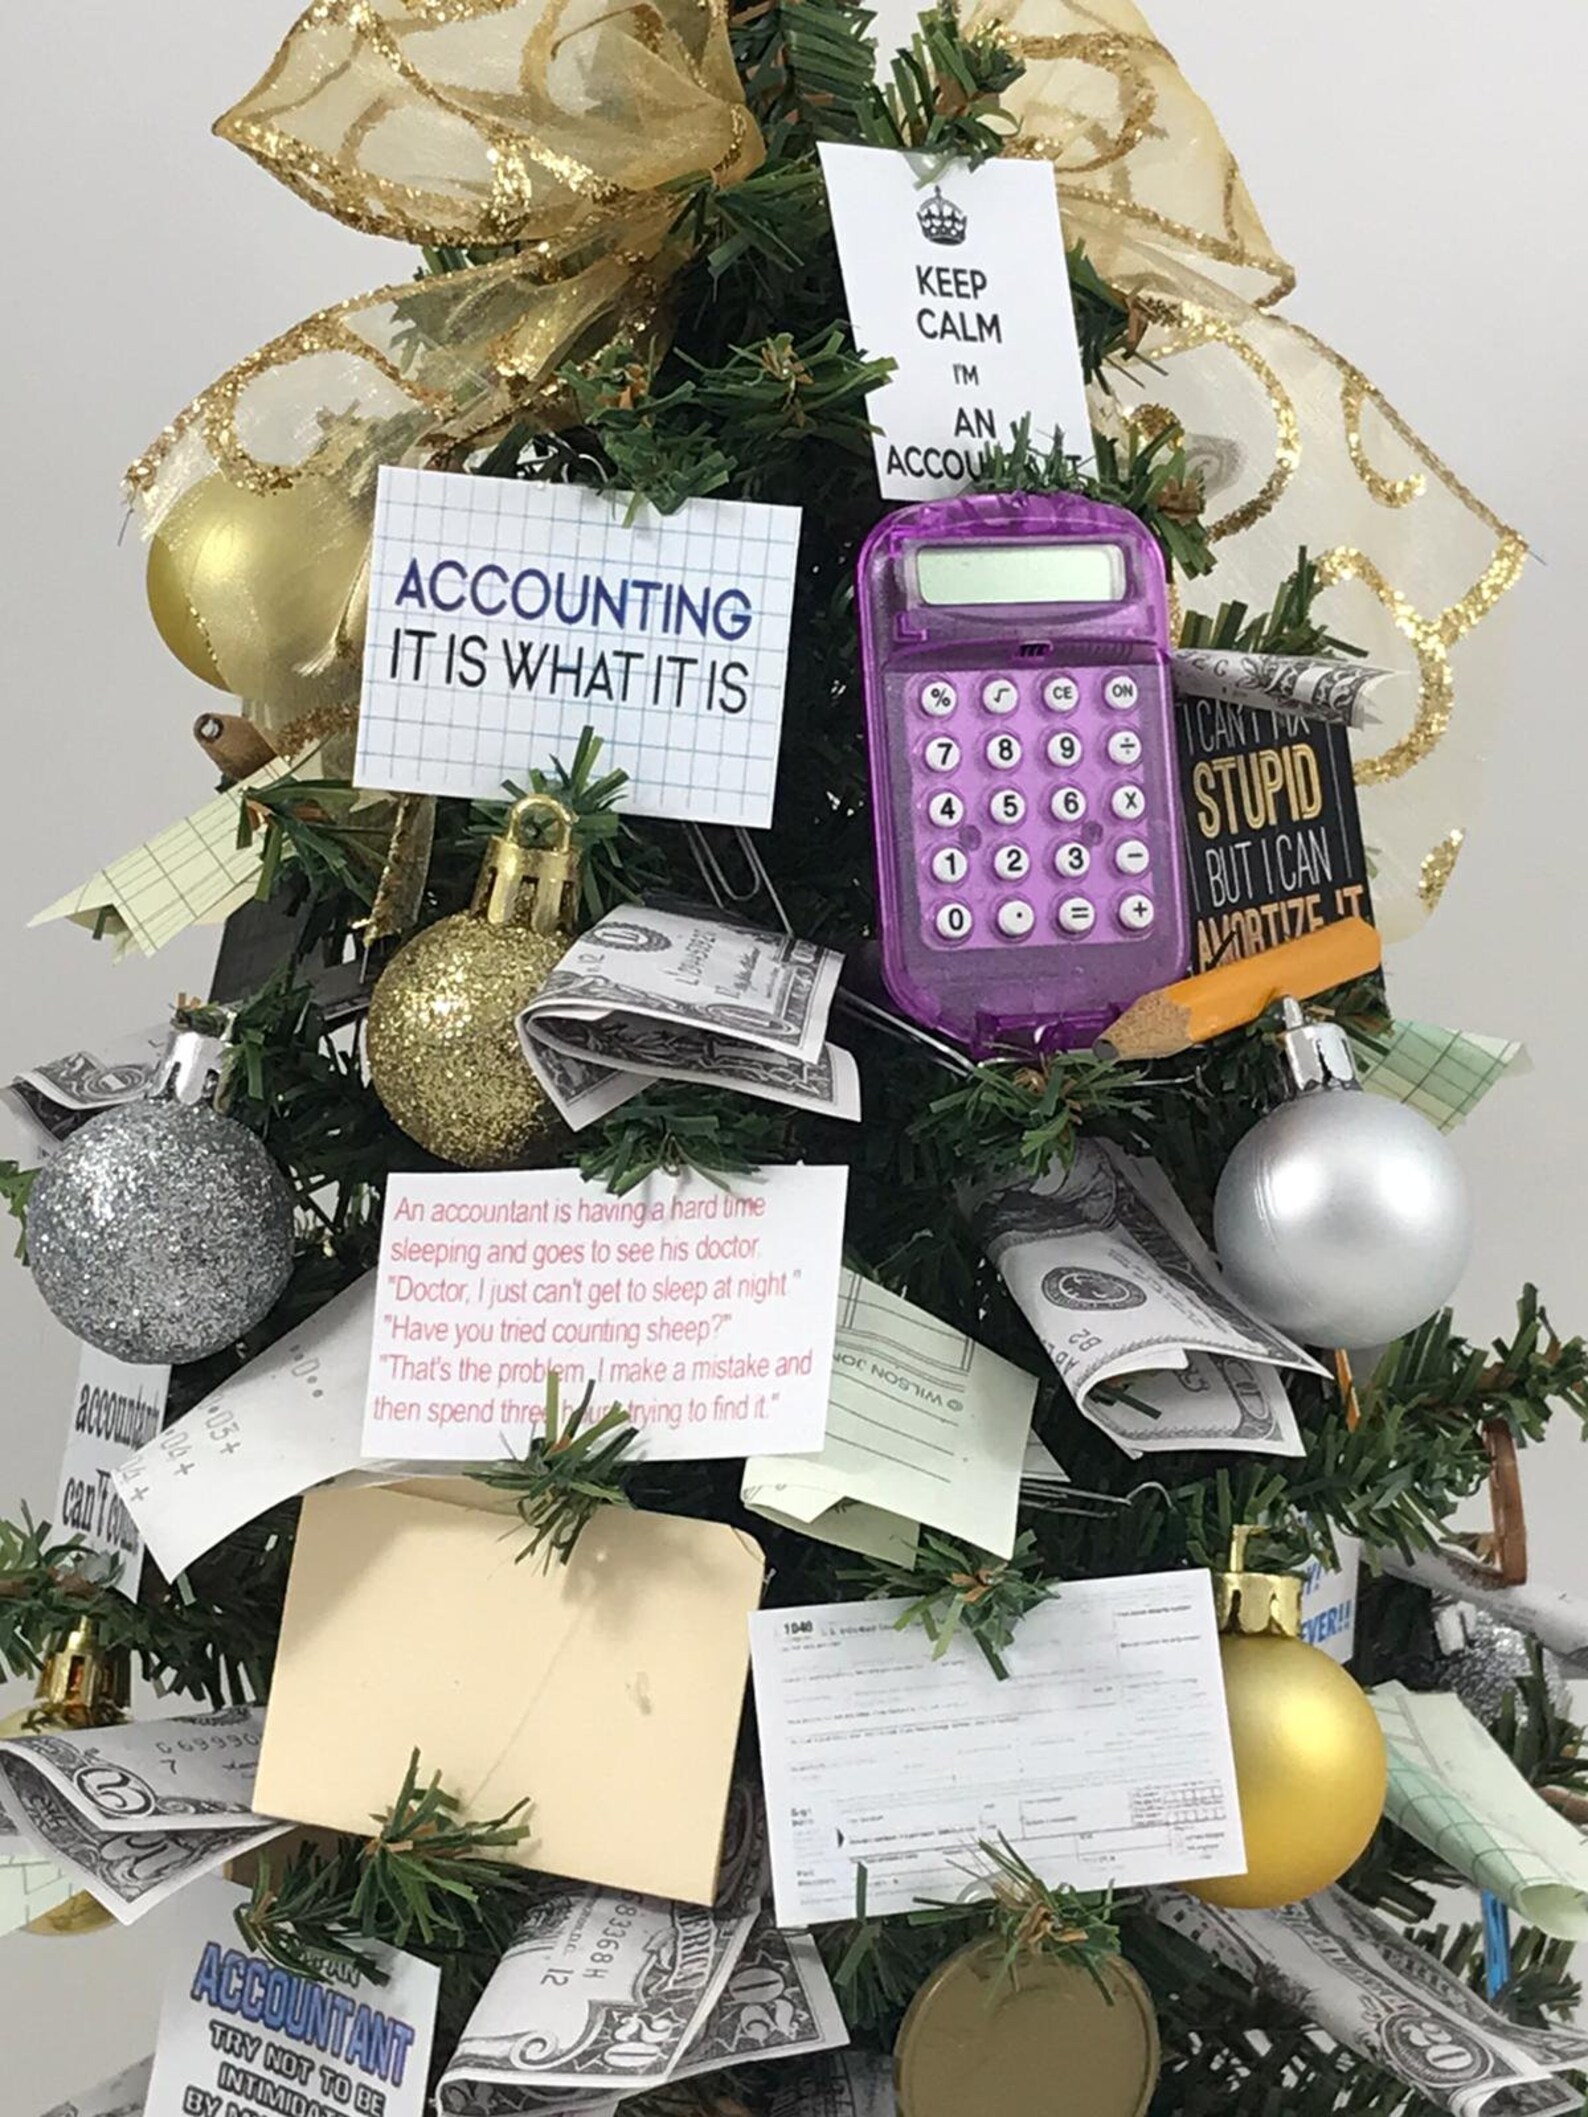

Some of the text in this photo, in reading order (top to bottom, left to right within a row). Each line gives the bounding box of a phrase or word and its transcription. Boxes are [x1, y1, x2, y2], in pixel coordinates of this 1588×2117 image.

[916, 265, 987, 299] KEEP
[917, 308, 1002, 343] CALM
[953, 363, 979, 386] I'M
[955, 407, 996, 439] AN
[395, 557, 752, 641] ACCOUNTING
[390, 628, 749, 714] IT IS WHAT IT IS
[1053, 686, 1073, 700] CE
[1112, 684, 1134, 699] ON
[936, 742, 952, 765] 7
[999, 739, 1013, 761] 8
[1060, 737, 1075, 759] 9
[940, 799, 956, 819] 4
[1003, 795, 1018, 817] 5
[1063, 792, 1078, 814] 6
[1193, 743, 1323, 839] STUPID
[945, 855, 957, 875] 1
[1006, 849, 1023, 871] 2
[1068, 848, 1084, 870] 3
[1205, 826, 1333, 908] BUT I CAN
[949, 909, 963, 931] 0
[394, 1194, 766, 1229] An accountant is having a hard time
[390, 1237, 481, 1270] sleeping
[487, 1238, 527, 1263] and
[532, 1243, 585, 1271] goes
[591, 1240, 611, 1263] to
[616, 1242, 655, 1263] see
[659, 1236, 689, 1261] his
[478, 1277, 485, 1302] I
[487, 1278, 528, 1309] just
[533, 1276, 582, 1304] can't
[587, 1278, 621, 1310] get
[627, 1277, 647, 1301] to
[652, 1276, 708, 1306] sleep
[713, 1275, 732, 1300] at
[384, 1314, 449, 1342] "Have
[453, 1322, 494, 1349] you
[500, 1317, 546, 1343] tried
[552, 1317, 640, 1349] counting
[459, 1356, 491, 1382] the
[597, 1355, 604, 1381] I
[610, 1357, 667, 1383] make
[673, 1361, 686, 1382] a
[692, 1353, 769, 1381] mistake
[775, 1348, 813, 1377] and
[871, 1363, 943, 1407] WILSON
[373, 1395, 420, 1421] then
[427, 1398, 494, 1429] spend
[629, 1400, 682, 1430] trying
[688, 1397, 707, 1422] to
[713, 1394, 748, 1420] find
[191, 1940, 414, 2087] ACCOUNTANT
[210, 2018, 386, 2116] TRY NOT TO BE
